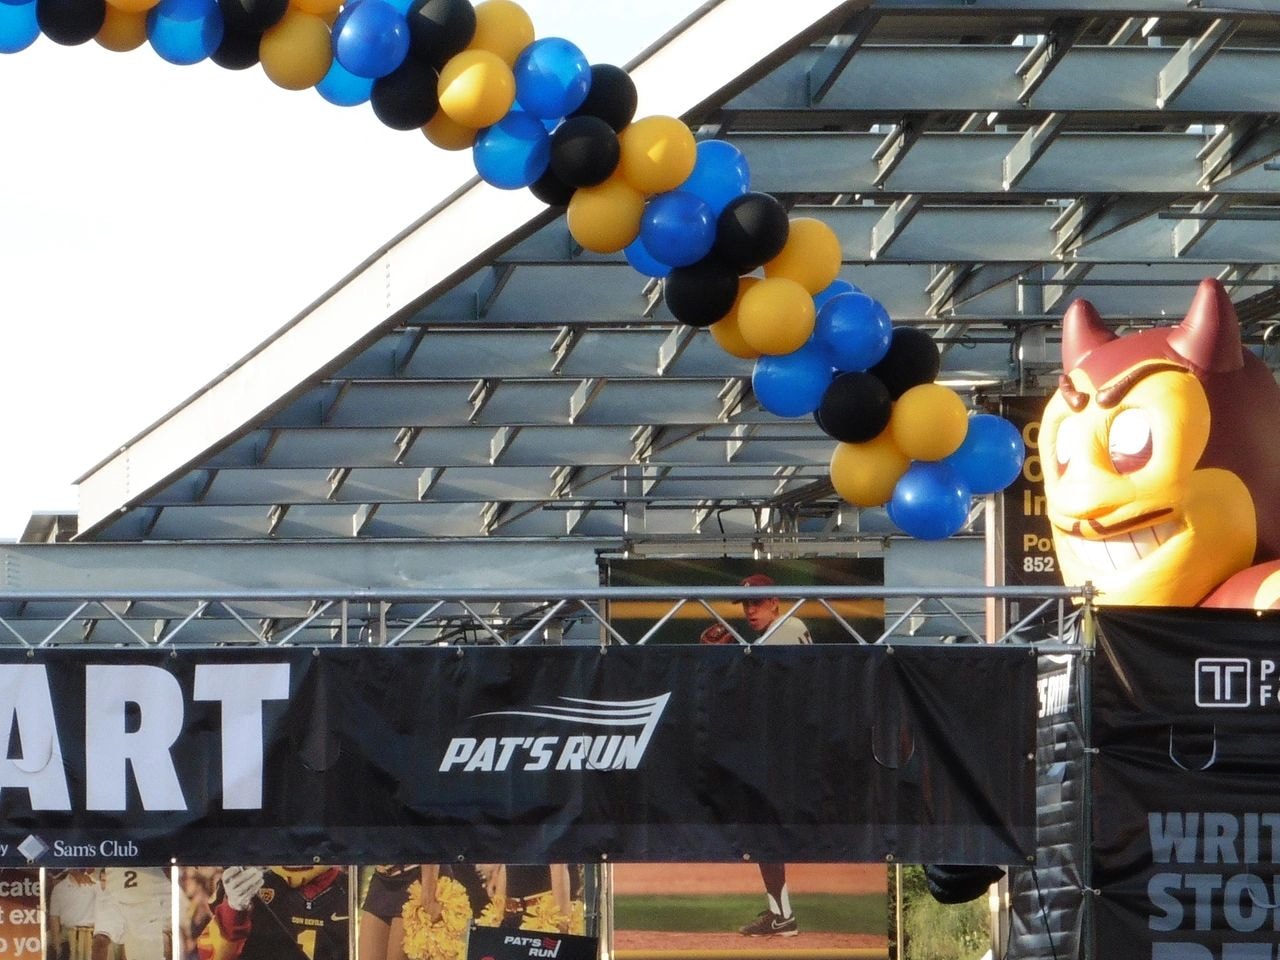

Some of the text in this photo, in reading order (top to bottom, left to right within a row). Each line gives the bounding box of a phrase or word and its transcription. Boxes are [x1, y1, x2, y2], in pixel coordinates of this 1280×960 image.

[1024, 534, 1052, 552] Po
[1024, 557, 1054, 572] 852
[438, 735, 646, 772] PAT'S RUN
[53, 840, 97, 857] Sam's
[100, 840, 138, 857] Club
[124, 870, 138, 889] 2
[1147, 873, 1280, 932] STO
[504, 936, 541, 948] PAT'S
[528, 948, 556, 958] RUN
